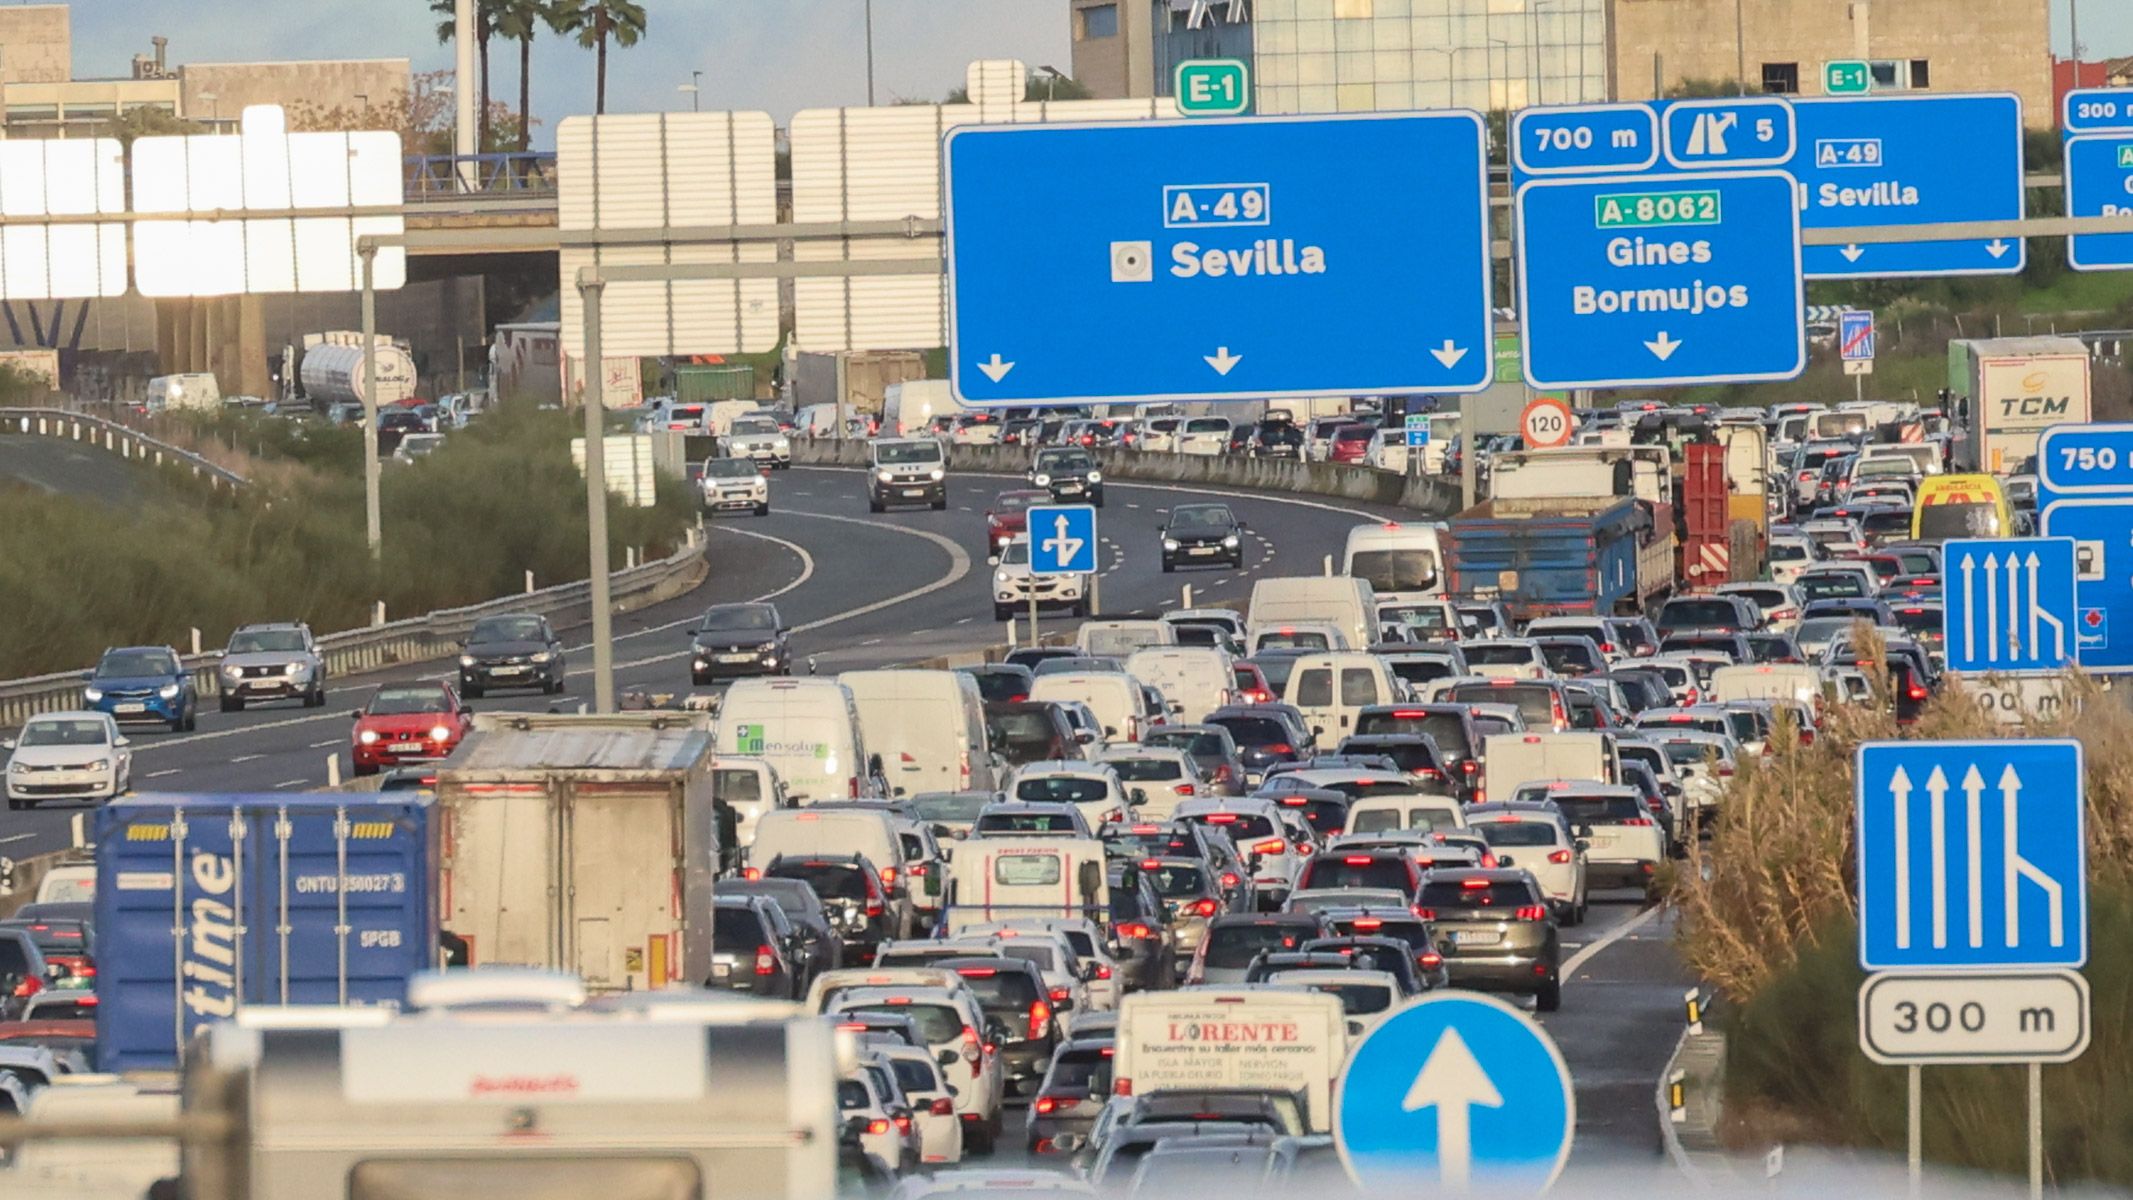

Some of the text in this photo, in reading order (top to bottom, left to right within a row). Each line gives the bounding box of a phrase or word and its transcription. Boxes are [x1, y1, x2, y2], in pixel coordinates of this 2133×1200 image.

[1189, 74, 1235, 102] E-1
[1831, 69, 1864, 86] E-1
[2078, 102, 2117, 119] 300
[1536, 127, 1637, 151] 700 m
[1757, 119, 1773, 142] 5
[1821, 144, 1877, 164] A-49
[1819, 181, 1919, 206] Sevilla
[1171, 191, 1263, 220] A-49
[1601, 196, 1716, 222] A-8062
[1171, 239, 1325, 277] Sevilla
[1607, 237, 1711, 266] Gines
[1574, 280, 1749, 314] Bormujos
[2000, 397, 2069, 416] TCM
[1531, 416, 1561, 432] 120
[2061, 447, 2117, 470] 750
[1979, 692, 2016, 711] 00
[1894, 1002, 2055, 1034] 300 m
[1168, 1023, 1298, 1041] LORENTE
[1142, 1043, 1194, 1053] Encuentre
[1199, 1045, 1210, 1053] su
[1215, 1043, 1240, 1053] taller
[1184, 1058, 1223, 1067] MAYOR
